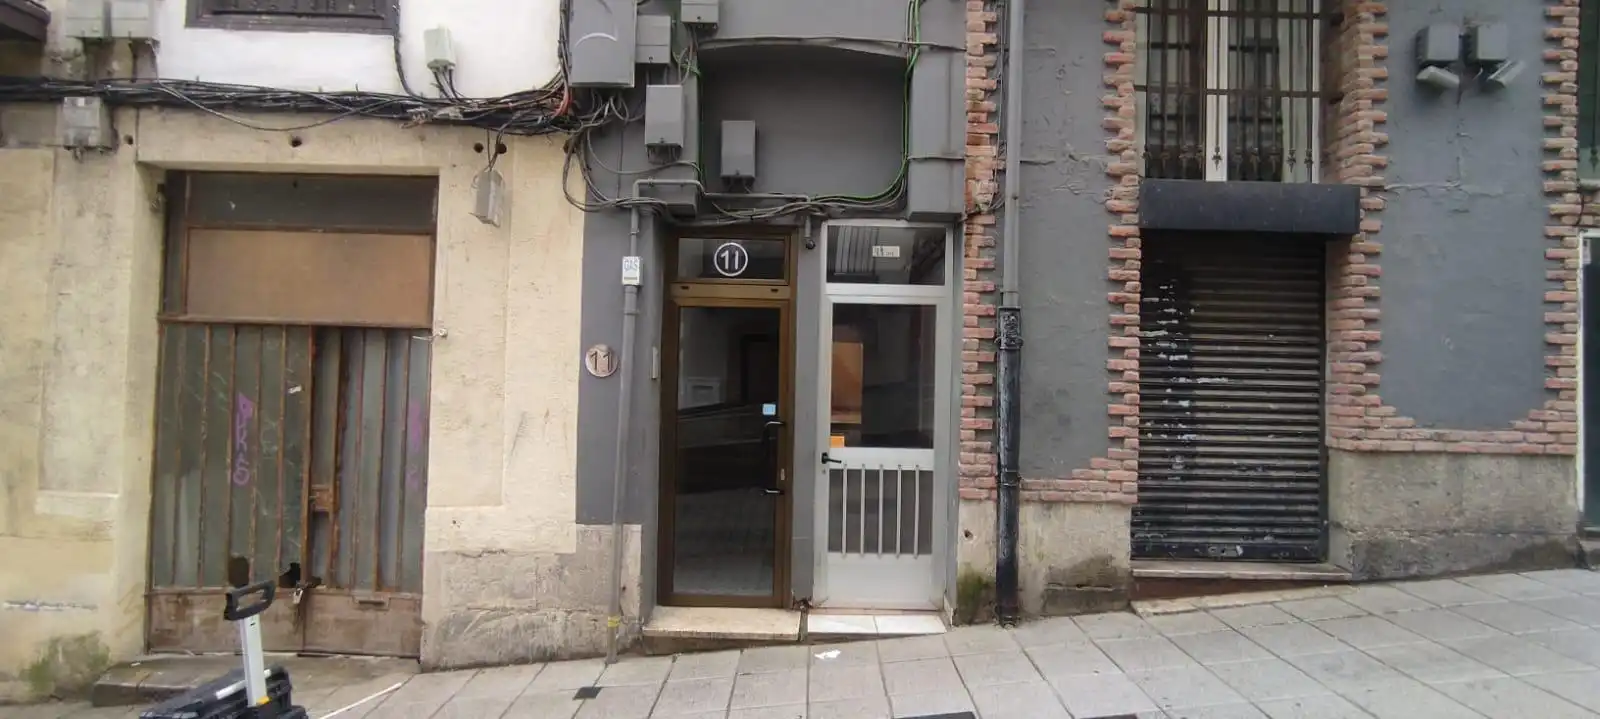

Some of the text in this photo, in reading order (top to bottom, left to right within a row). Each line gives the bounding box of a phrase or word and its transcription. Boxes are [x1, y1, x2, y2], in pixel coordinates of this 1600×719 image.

[624, 258, 638, 271] GAS
[720, 250, 738, 269] 11
[590, 351, 610, 370] 11
